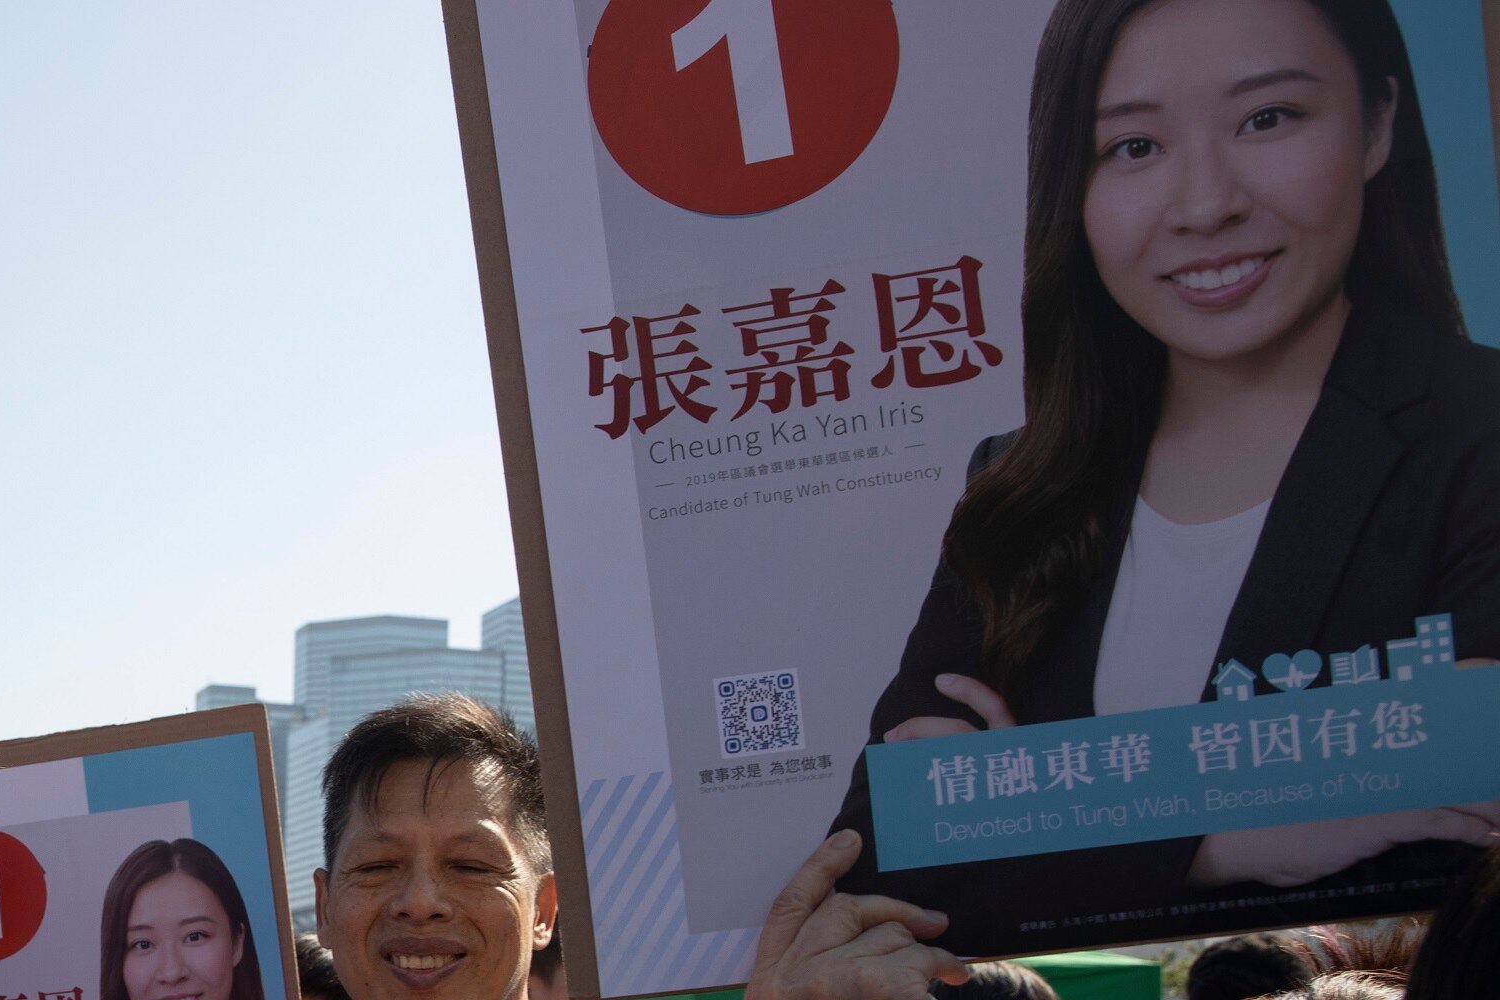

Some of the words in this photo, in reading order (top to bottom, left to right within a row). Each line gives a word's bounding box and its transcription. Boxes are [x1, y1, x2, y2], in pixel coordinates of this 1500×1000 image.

[670, 0, 795, 166] 1
[580, 255, 1003, 440] 張嘉恩
[649, 430, 763, 464] Cheung
[771, 420, 807, 445] Ka
[816, 411, 868, 438] Yan
[879, 401, 925, 428] Iris
[648, 496, 729, 521] Candidate
[732, 491, 749, 509] of
[752, 486, 794, 505] Tung
[795, 481, 831, 499] Wah
[835, 465, 943, 493] Constituency
[699, 763, 762, 785] 實事求是
[769, 754, 833, 776] 為您做事
[926, 733, 1153, 806] 情融東華
[1188, 700, 1430, 774] 皆因有您
[934, 813, 1032, 844] Devoted
[1039, 809, 1064, 831] to
[1069, 804, 1129, 830] Tung
[1136, 793, 1198, 820] Wah,
[1206, 780, 1315, 811] Because
[1320, 774, 1346, 798] of
[1350, 768, 1401, 794] You
